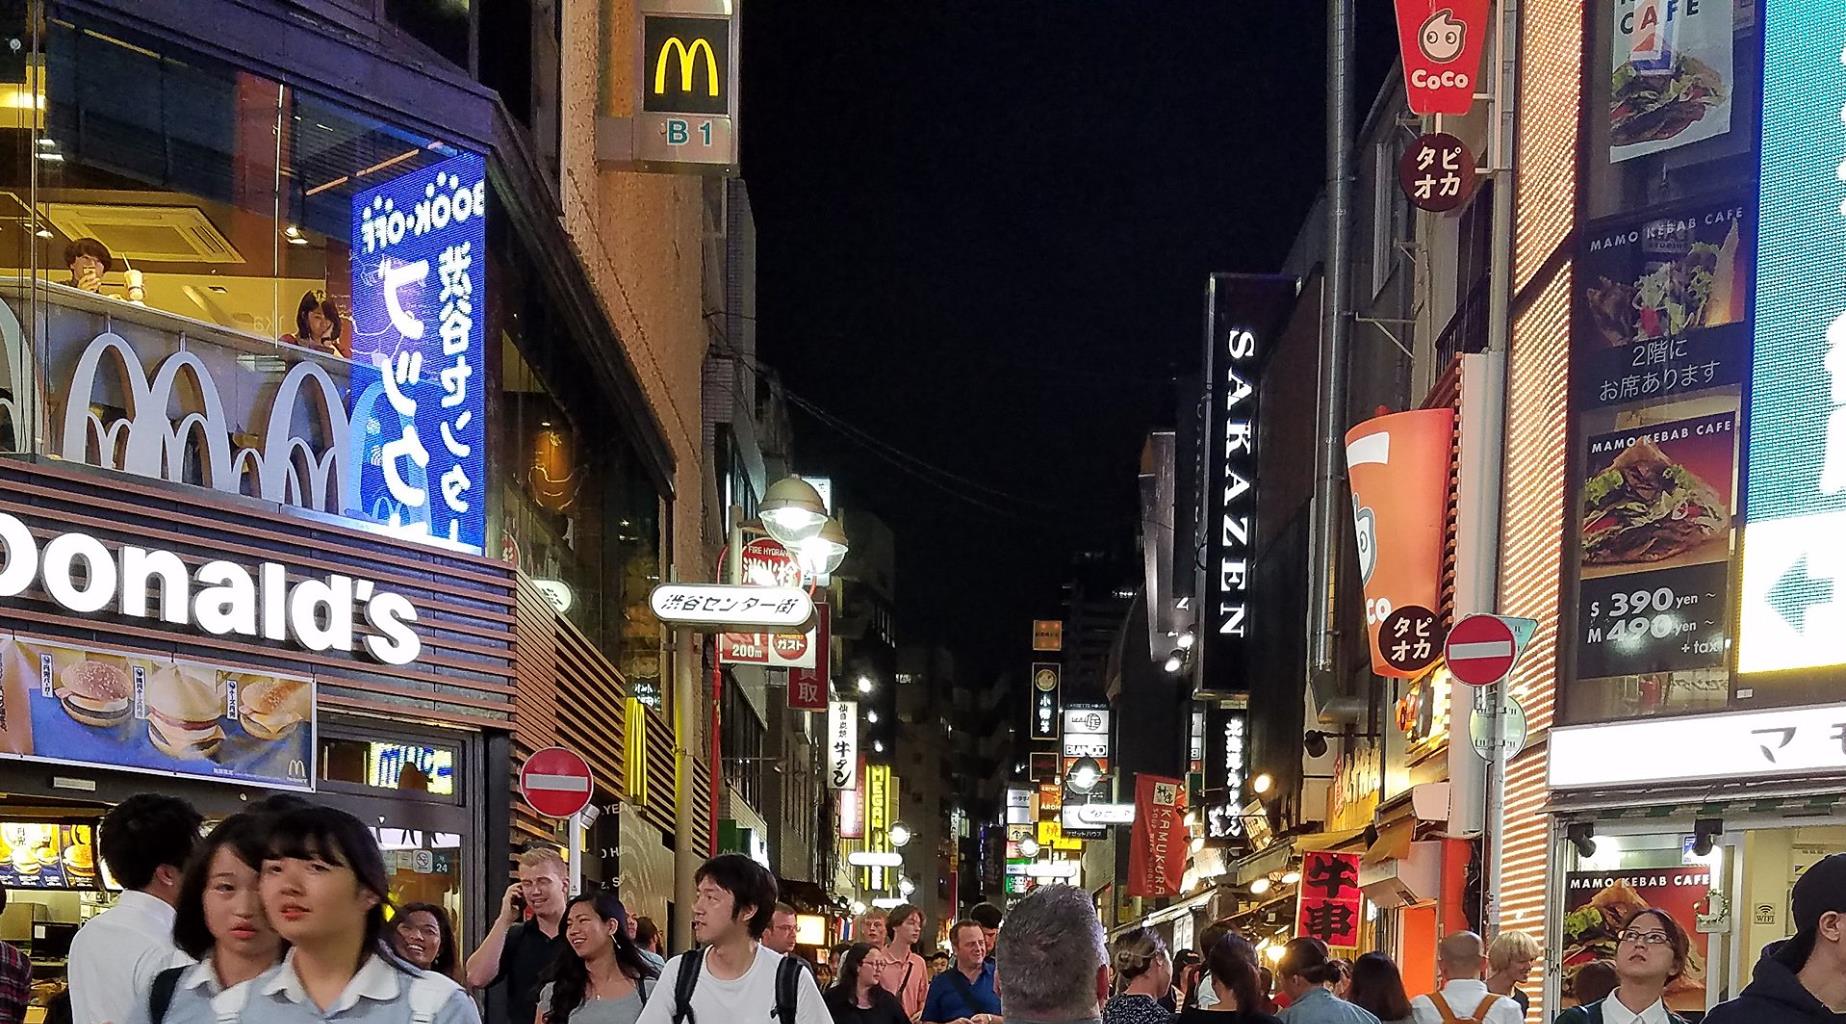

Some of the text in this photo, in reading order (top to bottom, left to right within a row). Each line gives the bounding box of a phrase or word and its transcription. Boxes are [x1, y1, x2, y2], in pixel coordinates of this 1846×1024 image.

[1620, 0, 1699, 34] CAFE
[1417, 146, 1461, 170] タピ
[1414, 172, 1460, 199] オカ
[1590, 231, 1638, 251] MAMO
[1647, 218, 1697, 239] KEBAB
[1705, 207, 1743, 225] CAFE
[1632, 340, 1688, 366] 2階に
[1599, 361, 1720, 401] お席あります
[1592, 421, 1731, 454] MAMO KEBAB CAFE
[1220, 328, 1255, 638] SAKAZEN
[661, 594, 799, 614] 渋谷センター街
[1590, 601, 1600, 617] S
[1609, 587, 1674, 617] 390
[1676, 595, 1698, 609] yen
[1393, 617, 1433, 638] タピ
[1587, 628, 1602, 643] M
[1606, 614, 1673, 641] 490
[1673, 622, 1697, 636] yen
[1391, 639, 1431, 662] オカ
[1694, 640, 1718, 654] tax
[1155, 808, 1172, 895] KAMUKURA
[1570, 874, 1711, 889] MAMO KEBAB CAFE
[1304, 855, 1358, 943] 牛串
